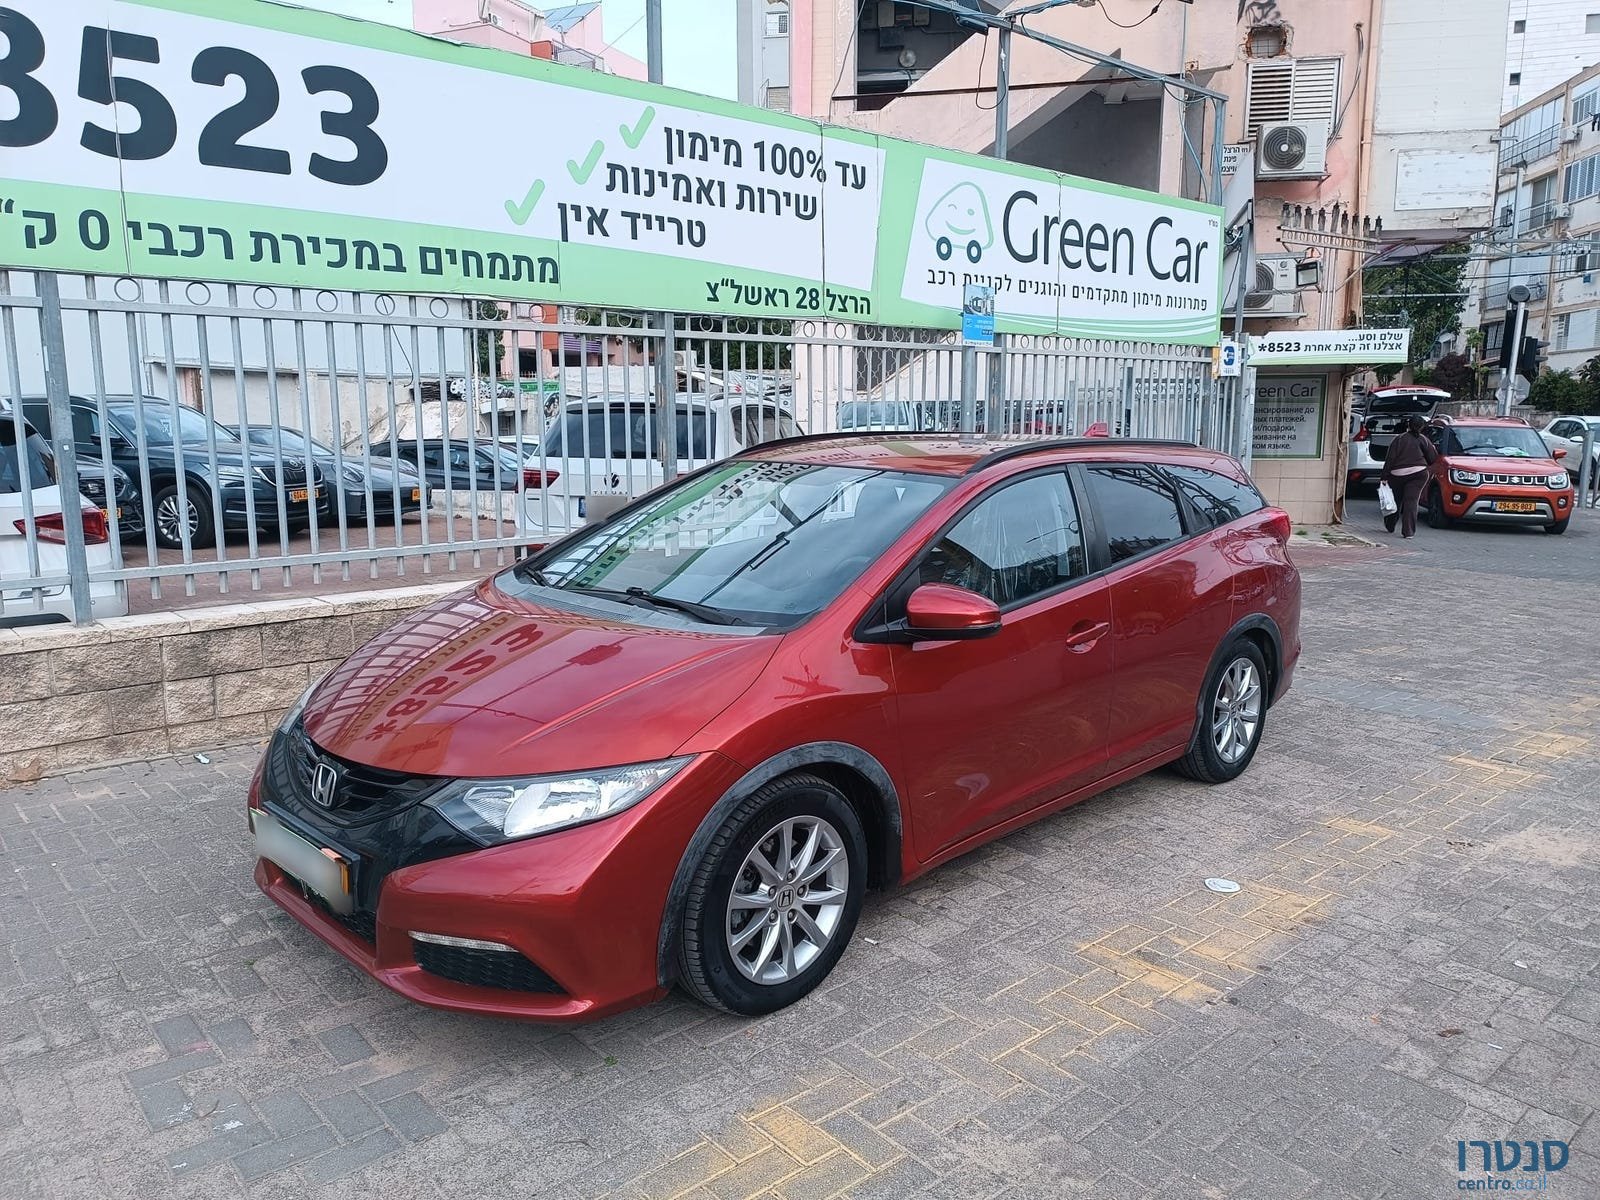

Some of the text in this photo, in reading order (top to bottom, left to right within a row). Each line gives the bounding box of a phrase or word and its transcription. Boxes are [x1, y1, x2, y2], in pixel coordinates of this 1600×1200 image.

[663, 126, 867, 190] עד 100% מימון
[605, 161, 818, 221] שירות ואמינות
[556, 202, 707, 248] טרייד אין
[126, 219, 234, 260] רכבי
[1002, 189, 1209, 285] Green Car
[249, 229, 407, 274] במכירת
[419, 244, 560, 285] מתמחים
[927, 268, 956, 287] רכב
[1018, 279, 1067, 298] והוגנים
[1071, 284, 1128, 306] מתקדמים
[795, 286, 820, 312] 28
[825, 288, 872, 315] הרצל
[1132, 290, 1162, 308] מימון
[1165, 294, 1208, 311] פתרונות
[1379, 331, 1404, 341] שלם
[1303, 343, 1332, 352] אחרת
[1334, 343, 1356, 353] קצת
[1359, 342, 1371, 351] זה
[1372, 341, 1403, 351] אצלנו
[1289, 383, 1318, 398] Car
[1304, 407, 1315, 415] до
